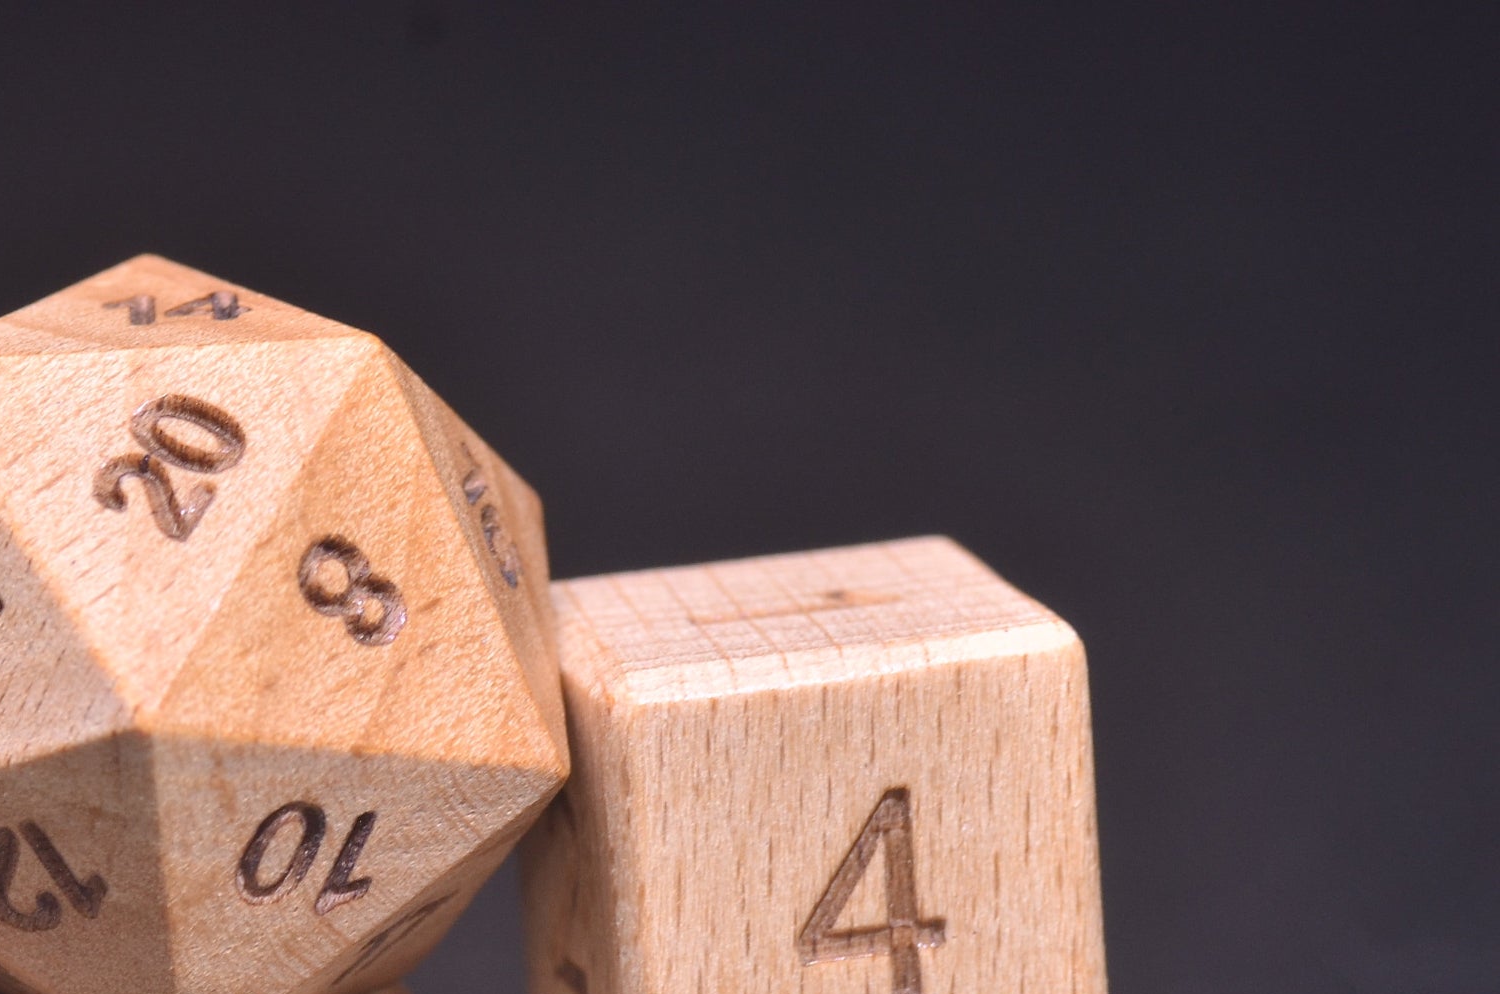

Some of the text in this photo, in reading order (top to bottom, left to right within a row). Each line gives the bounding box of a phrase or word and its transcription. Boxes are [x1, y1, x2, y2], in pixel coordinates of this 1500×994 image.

[102, 291, 251, 325] 14
[93, 394, 248, 542] 20
[300, 534, 408, 647] 8
[235, 801, 379, 915] 10
